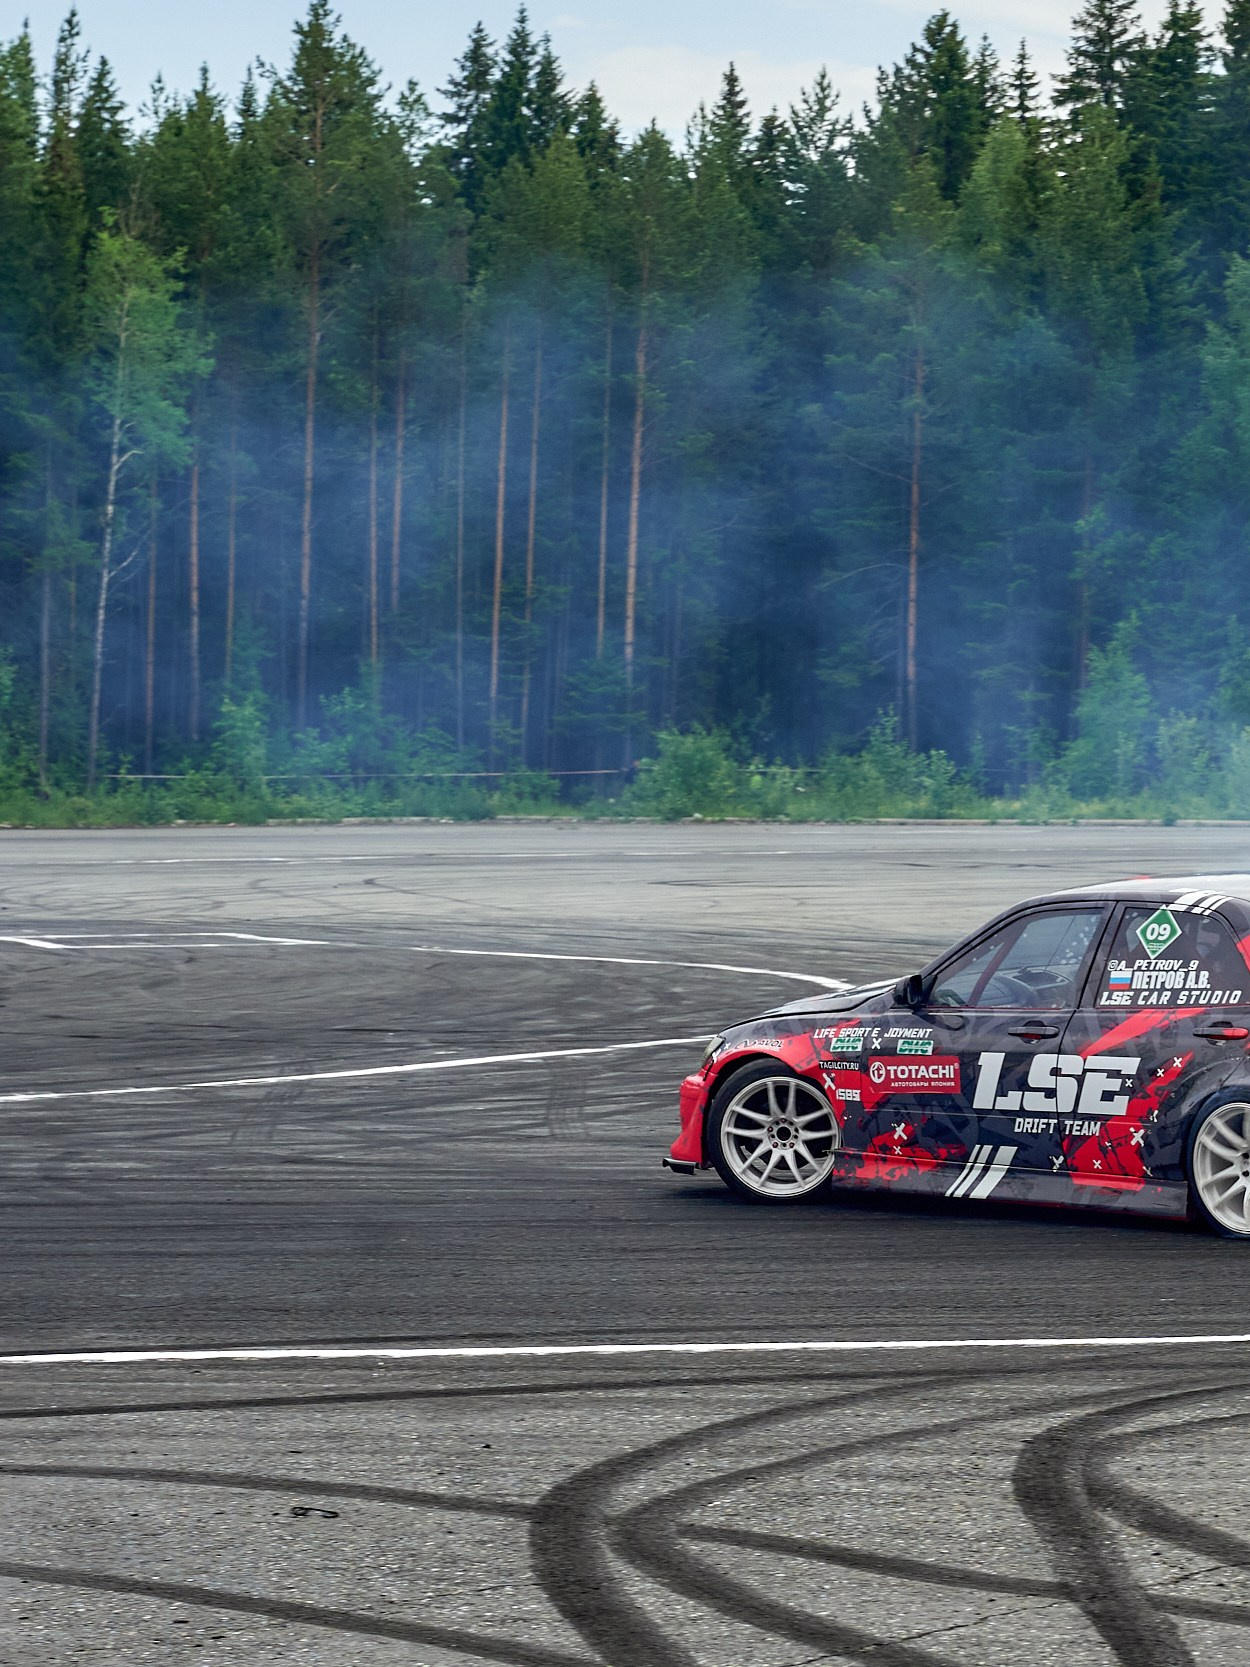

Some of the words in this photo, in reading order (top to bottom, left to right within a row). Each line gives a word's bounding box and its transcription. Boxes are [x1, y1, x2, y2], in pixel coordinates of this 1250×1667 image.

[1146, 923, 1171, 941] 09
[1107, 960, 1199, 971] @A_PETROV_9
[1131, 971, 1185, 989] ПЕТРОВ
[1100, 991, 1135, 1005] LSE
[1137, 991, 1171, 1005] CAR
[1177, 990, 1242, 1005] STUDIO
[813, 1028, 838, 1038] LIFE
[839, 1028, 872, 1038] SPORT
[886, 1065, 954, 1079] TOTACHI
[972, 1052, 1142, 1116] LSE
[1014, 1118, 1057, 1134] DRIFT
[1064, 1121, 1100, 1136] TEAM
